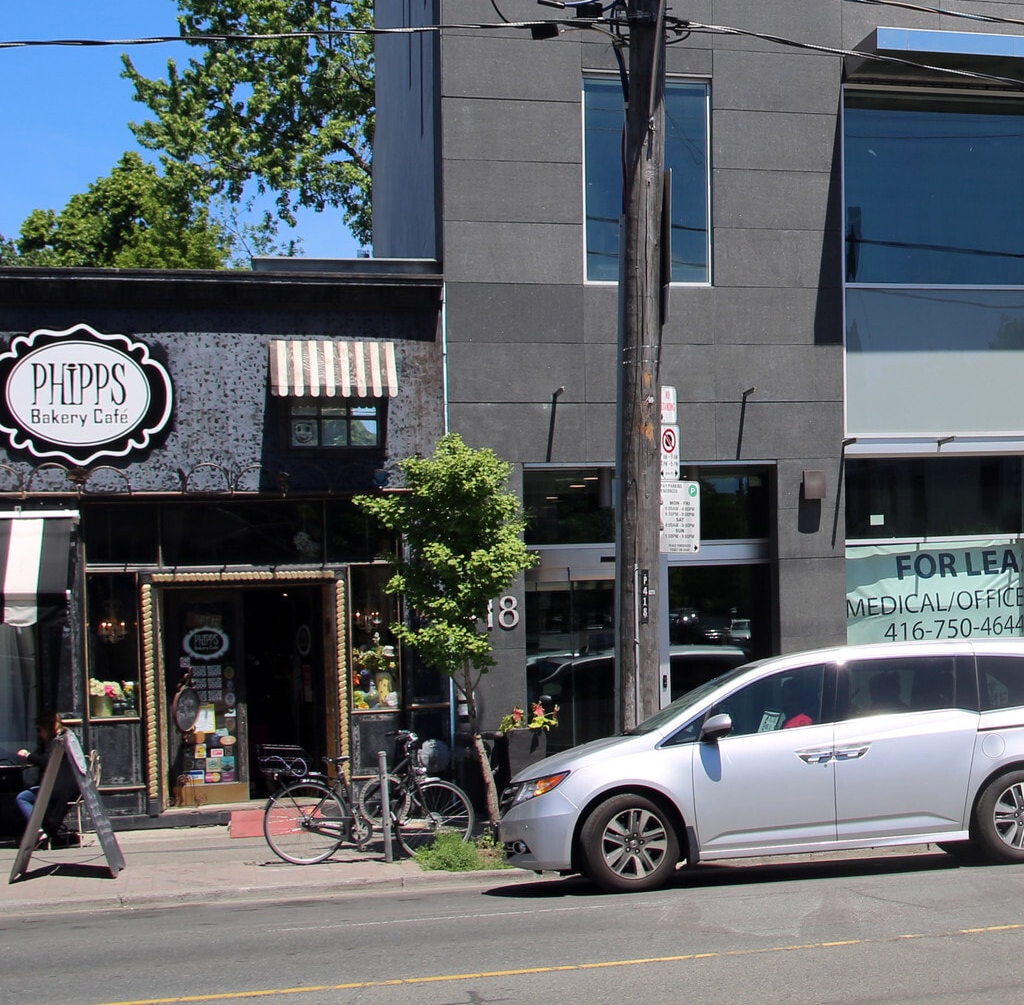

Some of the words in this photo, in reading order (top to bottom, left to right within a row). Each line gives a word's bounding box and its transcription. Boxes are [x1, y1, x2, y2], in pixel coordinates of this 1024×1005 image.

[31, 409, 88, 427] Bakery
[93, 408, 128, 424] Café
[895, 552, 958, 581] FOR
[884, 614, 1024, 642] 416-750-4644
